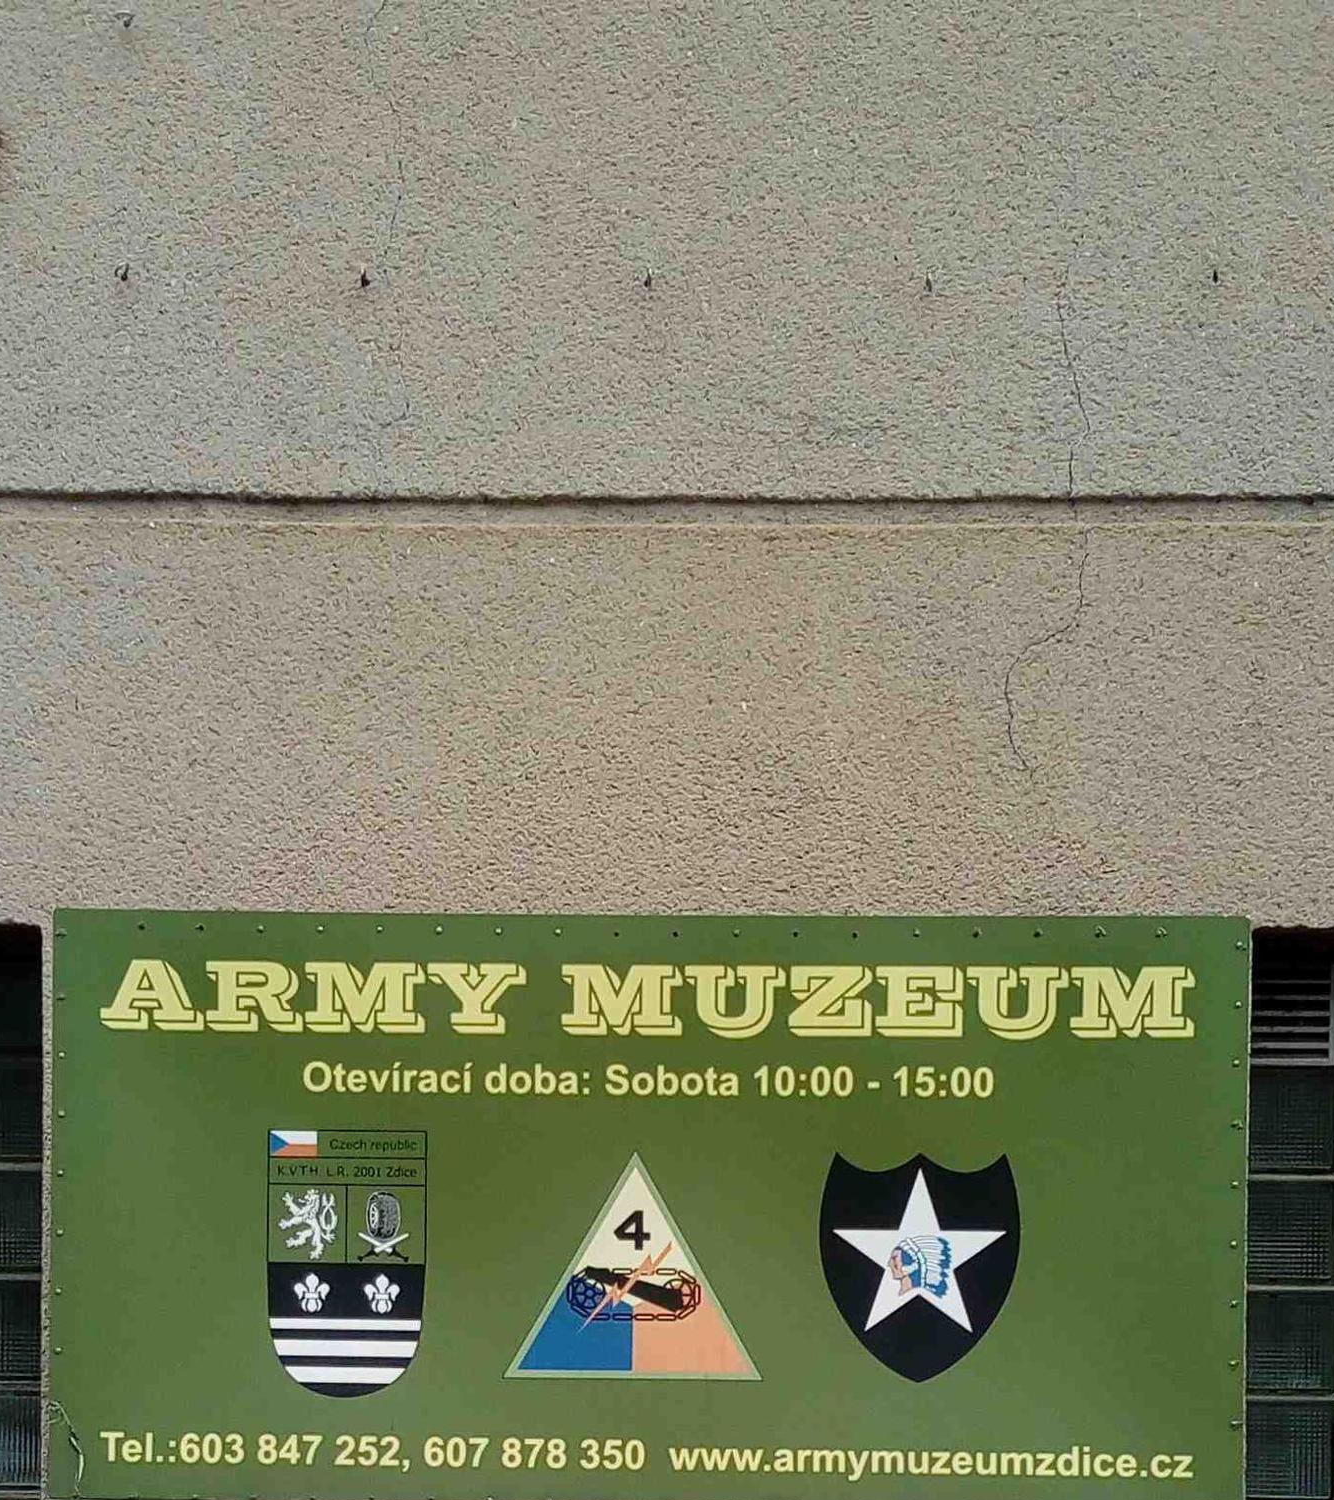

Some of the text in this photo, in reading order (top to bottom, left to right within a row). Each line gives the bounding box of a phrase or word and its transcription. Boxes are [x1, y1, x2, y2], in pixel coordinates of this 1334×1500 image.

[100, 959, 1196, 1040] ARMY MUZEUM
[303, 1061, 473, 1094] Otevírací
[484, 1062, 590, 1095] doba:
[604, 1064, 739, 1097] Sobota
[753, 1065, 854, 1097] 10:00
[893, 1065, 995, 1098] 15:00
[329, 1138, 418, 1152] Czech republic
[386, 1166, 417, 1178] Zdice
[613, 1210, 651, 1251] 4
[257, 1433, 320, 1465] 847
[334, 1434, 410, 1473] 252,
[423, 1436, 489, 1468] 607
[501, 1437, 567, 1469] 878
[579, 1438, 645, 1470] 350
[668, 1445, 1194, 1481] www.armymuzeumzdice.cz
